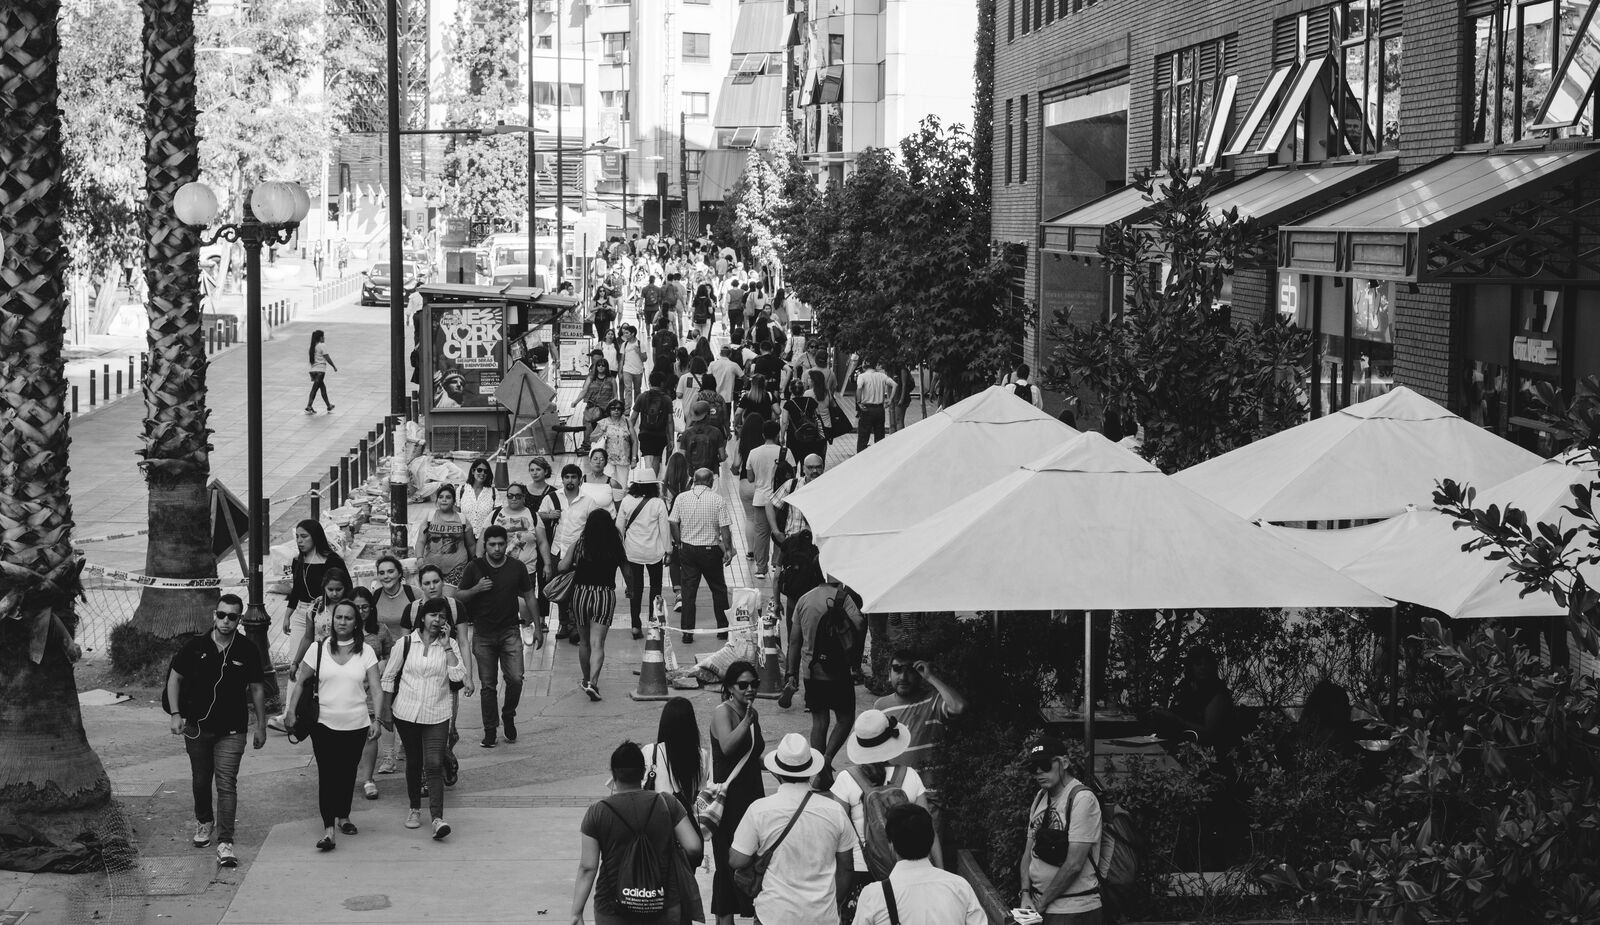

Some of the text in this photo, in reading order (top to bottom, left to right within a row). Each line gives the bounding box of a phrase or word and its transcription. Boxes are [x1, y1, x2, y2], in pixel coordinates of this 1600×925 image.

[440, 323, 503, 341] YORK
[443, 340, 497, 359] CITY
[622, 887, 657, 898] adidas
